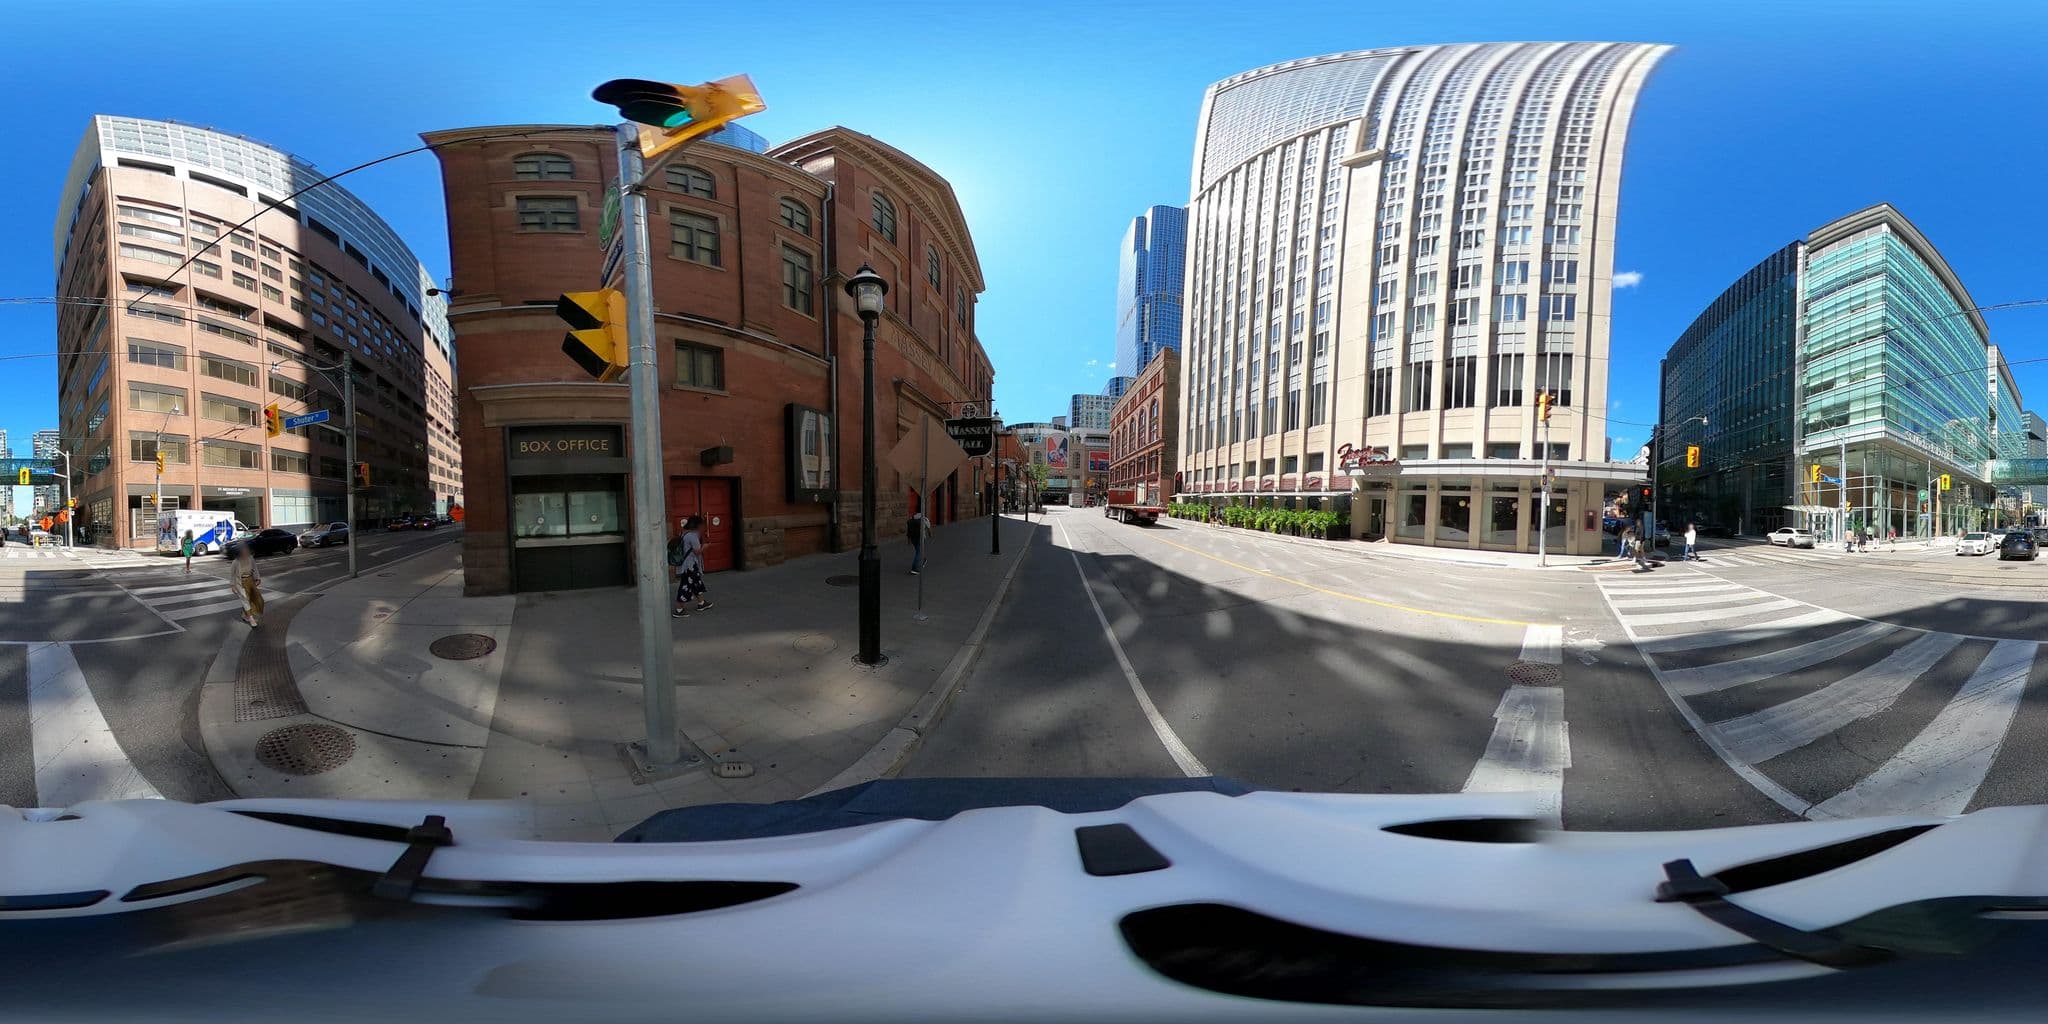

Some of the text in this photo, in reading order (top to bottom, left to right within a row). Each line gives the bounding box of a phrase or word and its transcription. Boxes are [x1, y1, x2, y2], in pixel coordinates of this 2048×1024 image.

[292, 415, 314, 425] Shuter
[520, 440, 608, 452] BOX OFFICE
